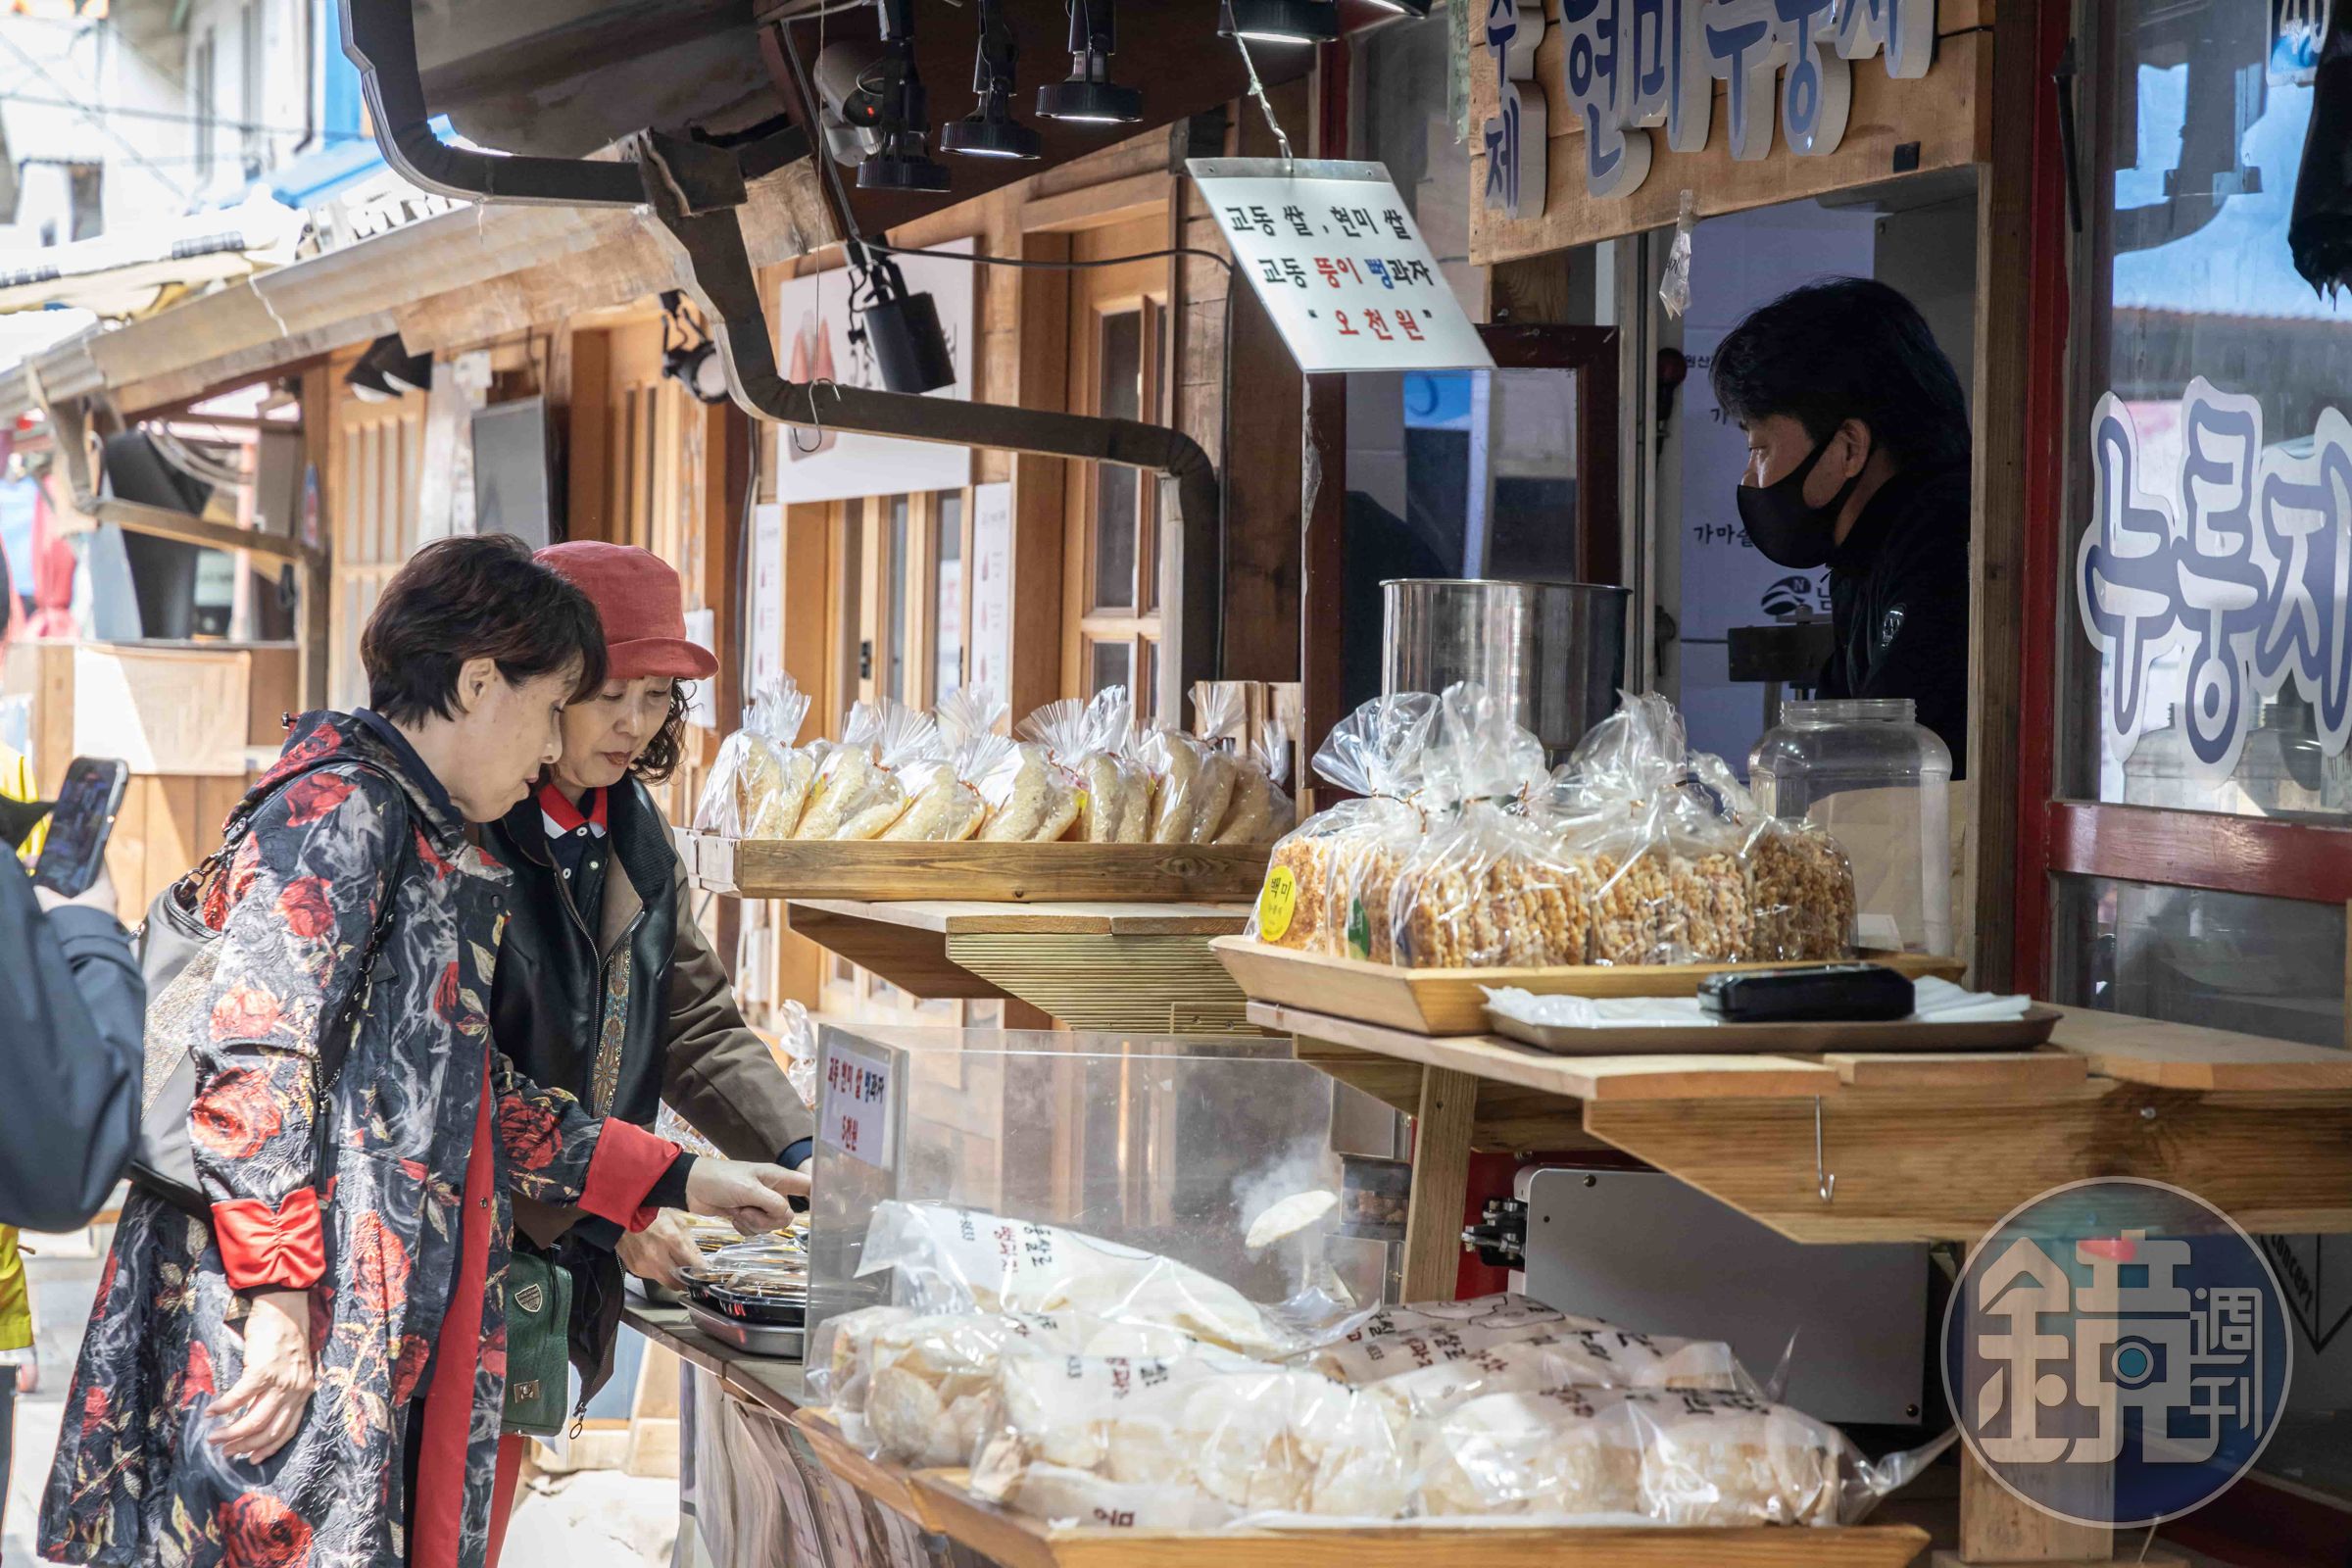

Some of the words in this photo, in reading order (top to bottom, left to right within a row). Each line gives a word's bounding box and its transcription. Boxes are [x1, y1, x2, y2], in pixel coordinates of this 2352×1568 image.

[1225, 205, 1277, 237] 교동
[1330, 206, 1380, 238] 현미
[1383, 209, 1412, 240] 쌀
[1258, 257, 1307, 289] 교동
[1313, 257, 1364, 289] 뚱이
[1367, 258, 1435, 290] 뻥과자
[1685, 354, 1714, 368] 원산
[2081, 390, 2352, 769] 누룽지
[1271, 877, 1292, 903] 백미
